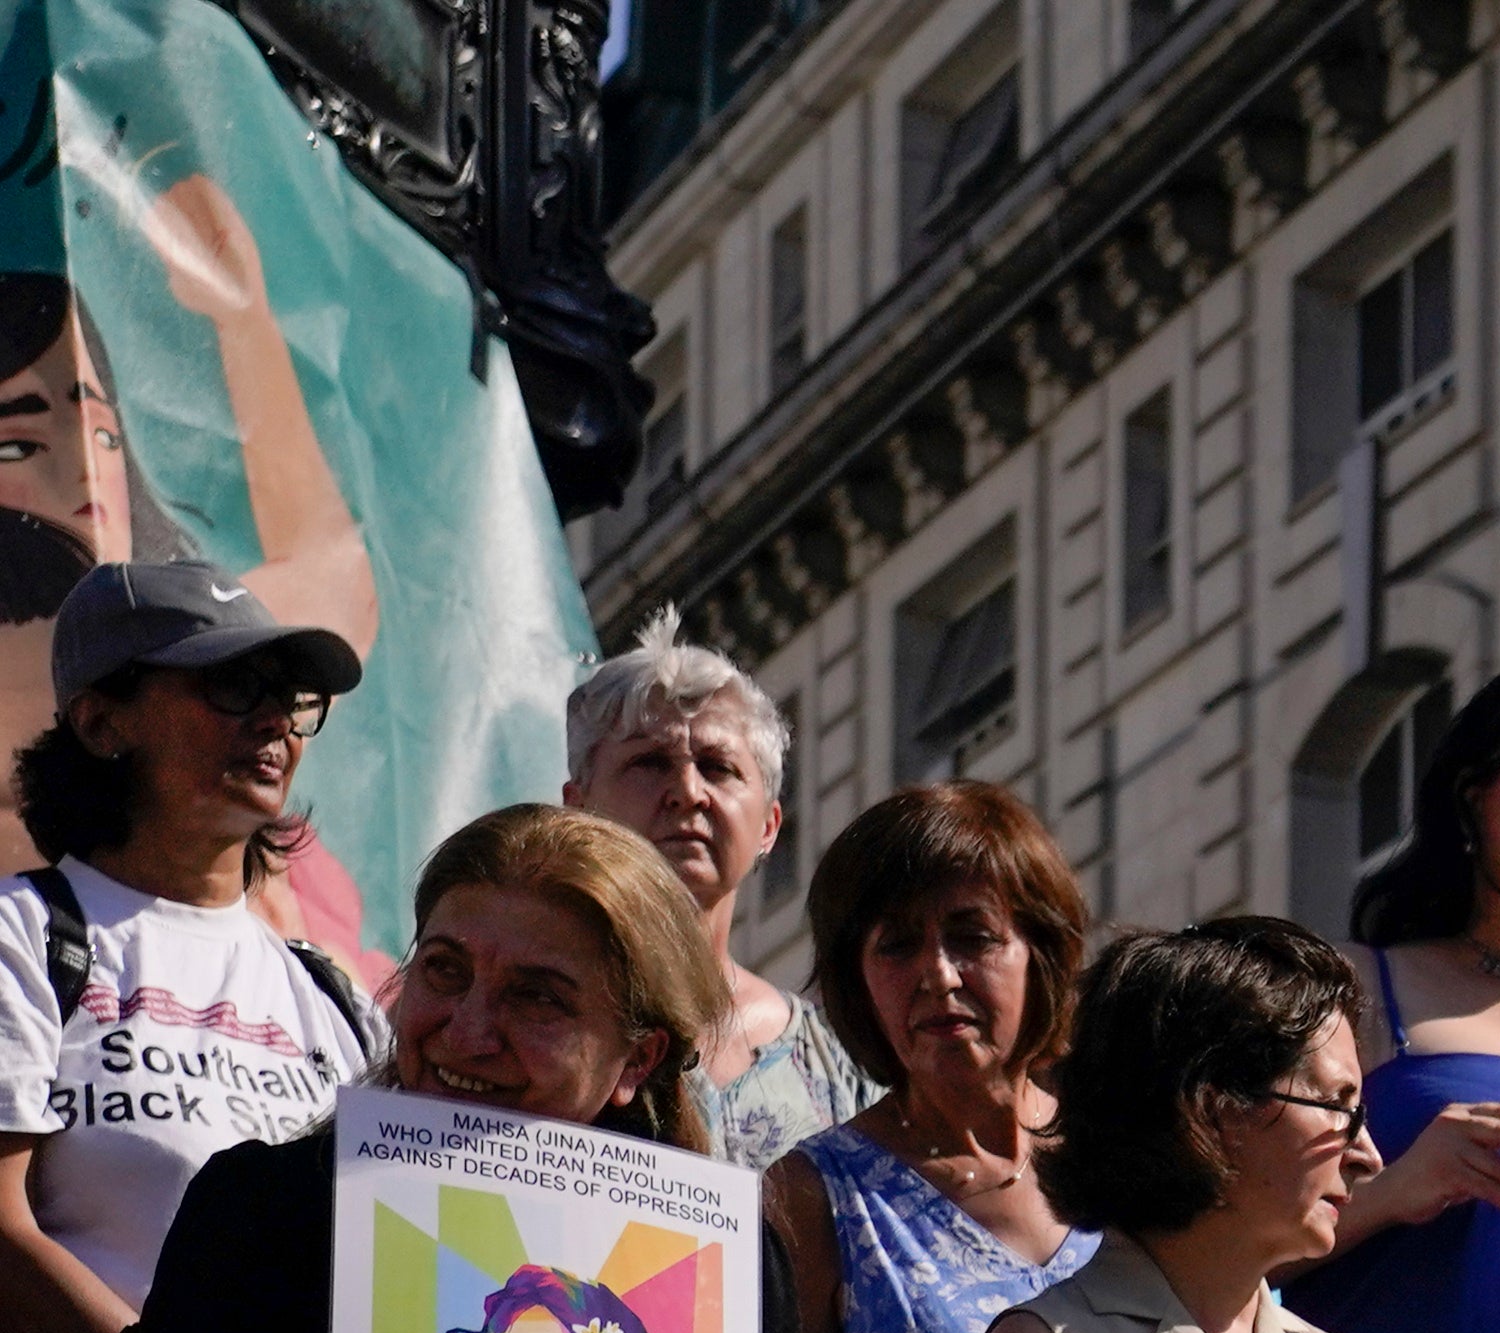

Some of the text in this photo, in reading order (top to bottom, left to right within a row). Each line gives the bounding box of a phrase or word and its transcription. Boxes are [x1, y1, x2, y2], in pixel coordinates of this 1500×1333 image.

[101, 1029, 319, 1106] Southall
[47, 1083, 212, 1131] Black
[453, 1112, 657, 1170] MAHSA (JINA) AMINI
[357, 1141, 739, 1233] AGAINST DECADES OF OPPRESSION
[379, 1121, 721, 1208] WHO IGNITED IRAN REVOLUTION
